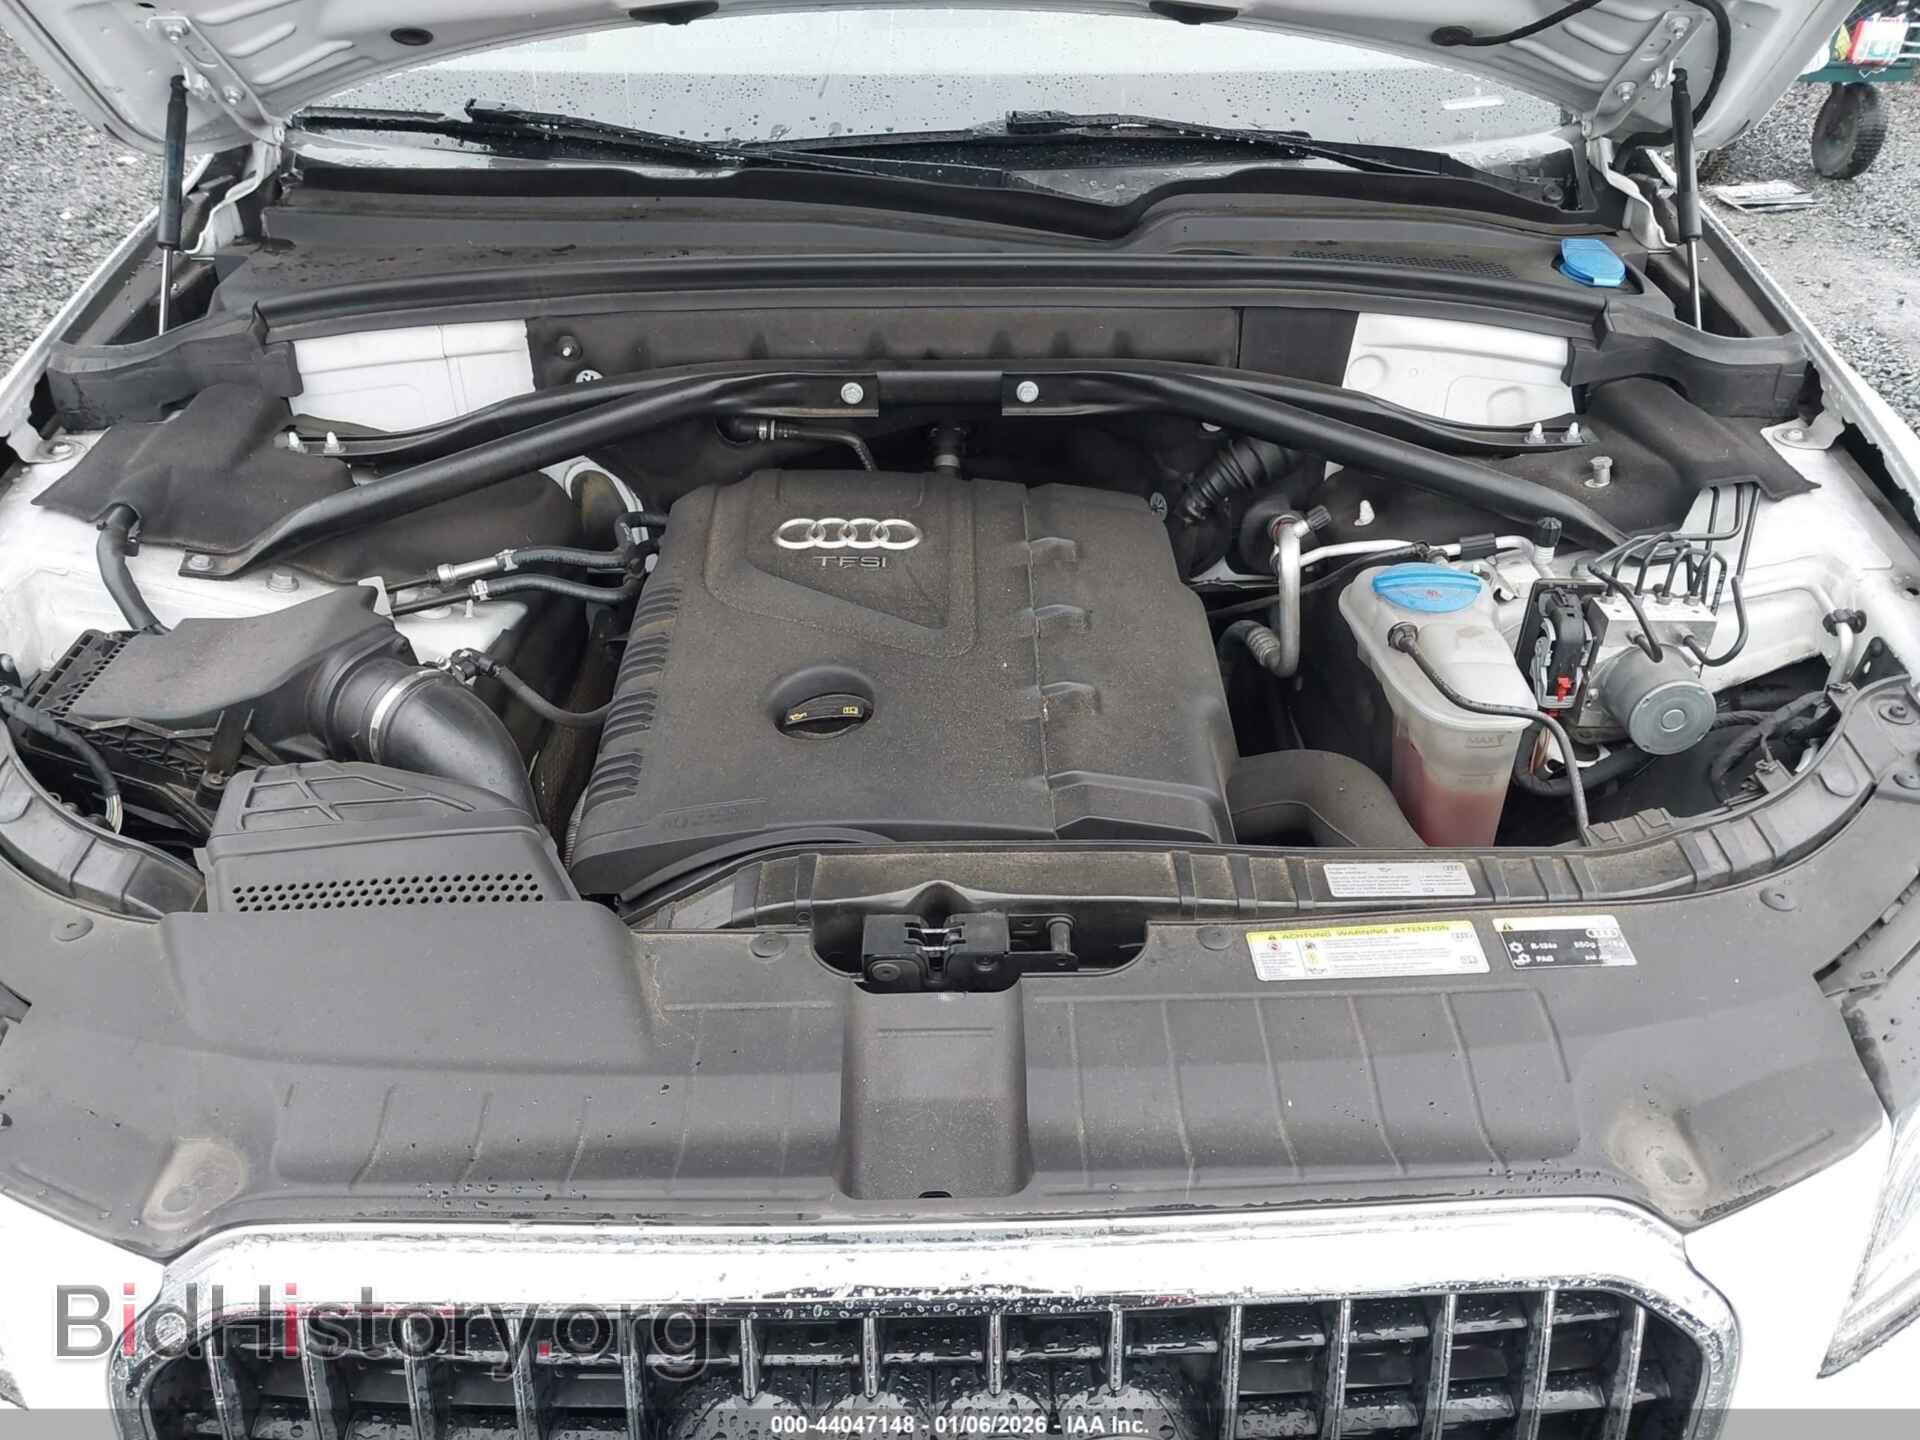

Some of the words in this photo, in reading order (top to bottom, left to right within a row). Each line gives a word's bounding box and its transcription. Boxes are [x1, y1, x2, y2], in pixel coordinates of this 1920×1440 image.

[813, 556, 886, 567] TFSI
[1281, 931, 1331, 940] ACHTUNG
[1337, 928, 1388, 937] WARNING
[1393, 924, 1451, 934] ATTENTION
